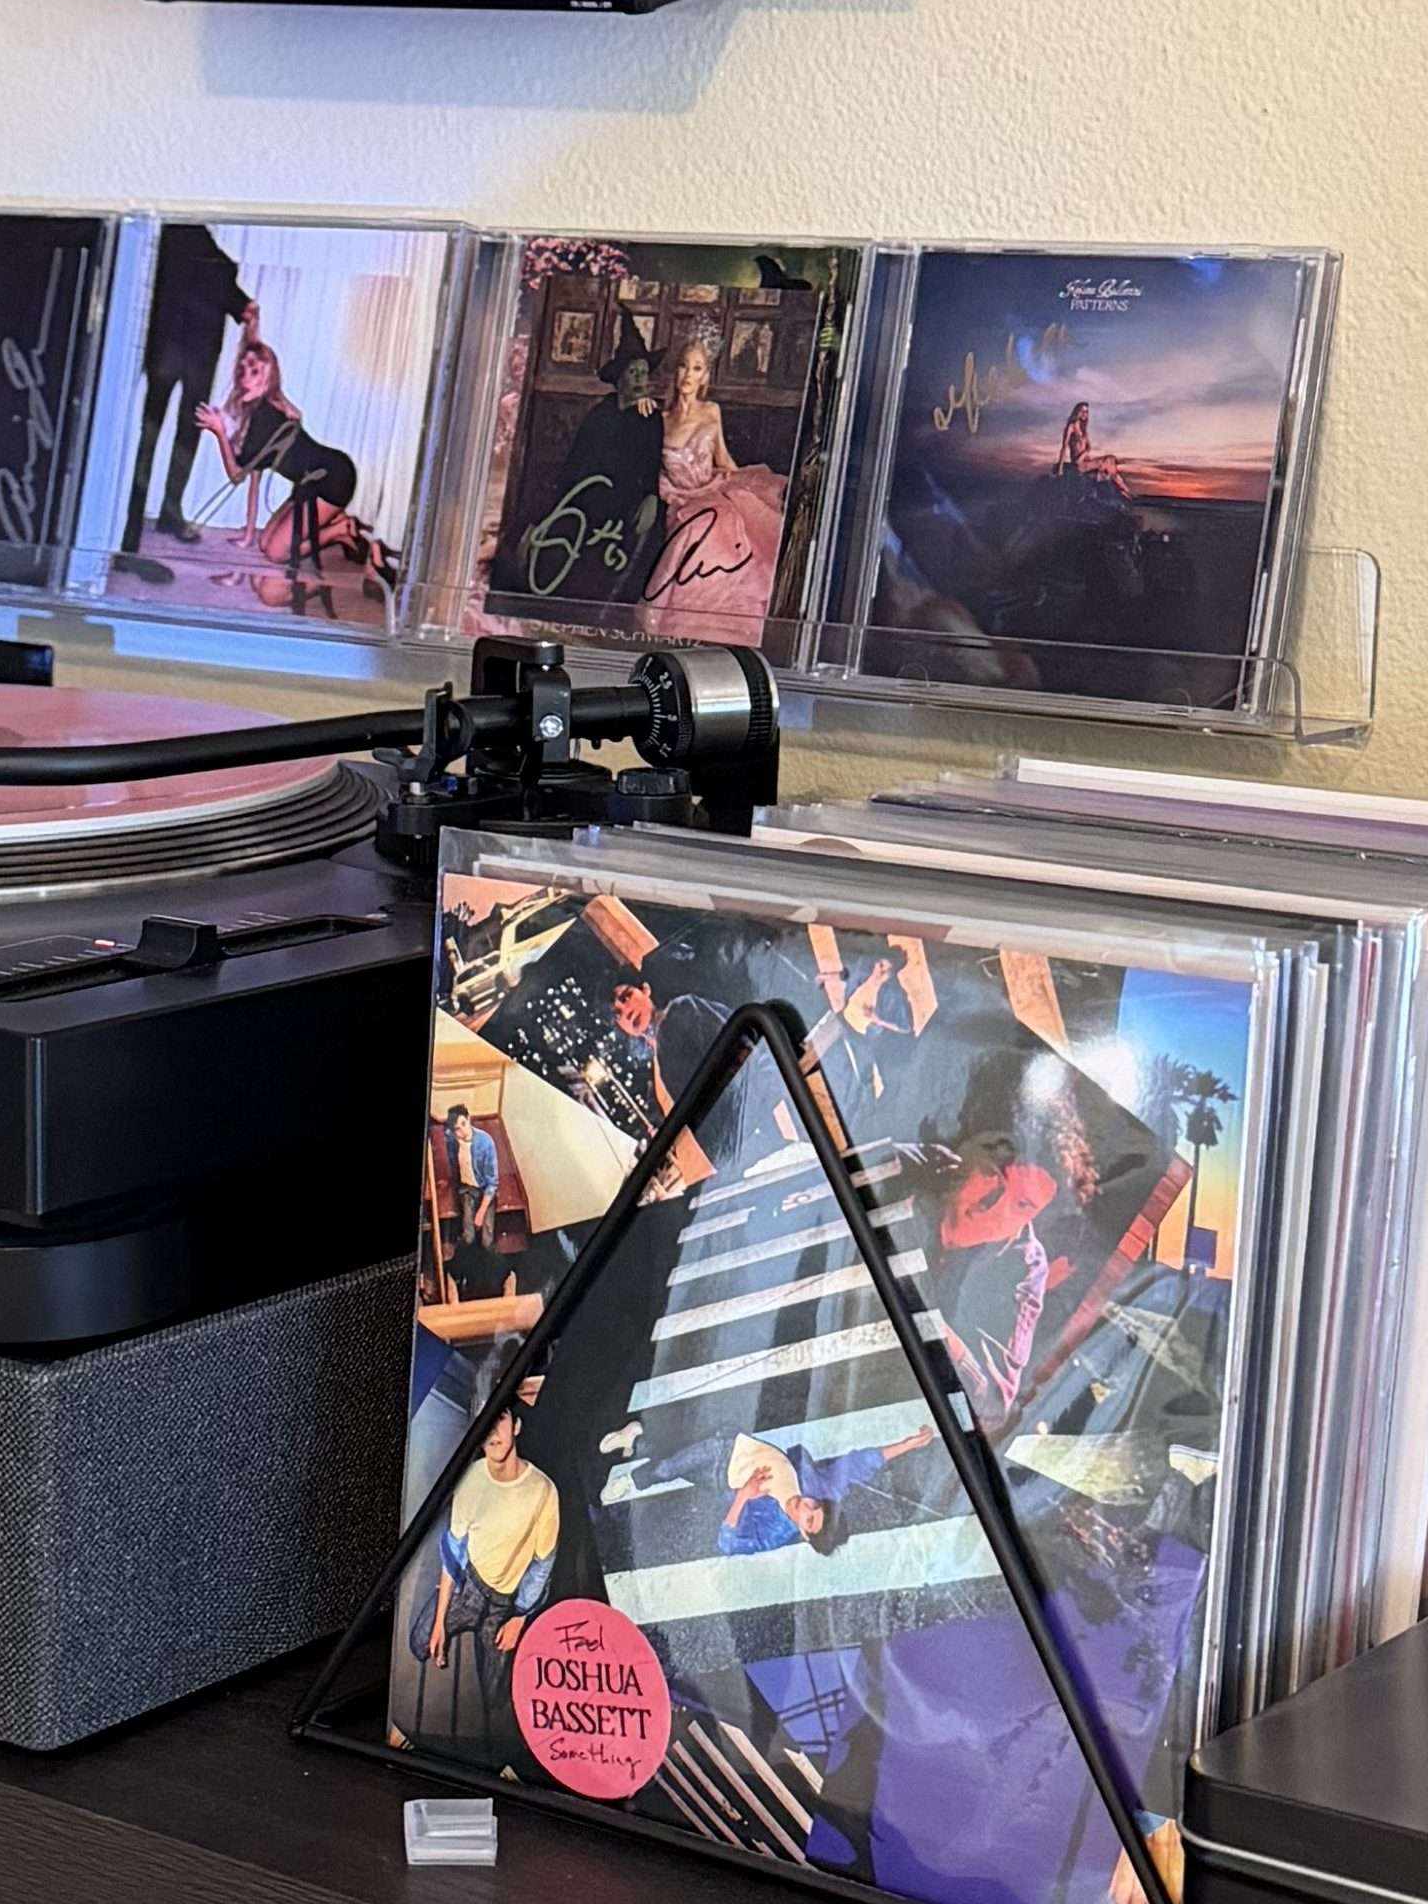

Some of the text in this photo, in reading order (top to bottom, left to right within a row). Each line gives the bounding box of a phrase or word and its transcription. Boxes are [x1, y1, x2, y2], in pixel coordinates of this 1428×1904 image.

[535, 1657, 644, 1696] JOSHUA
[531, 1699, 652, 1740] BASSETT
[550, 1737, 642, 1781] Something
